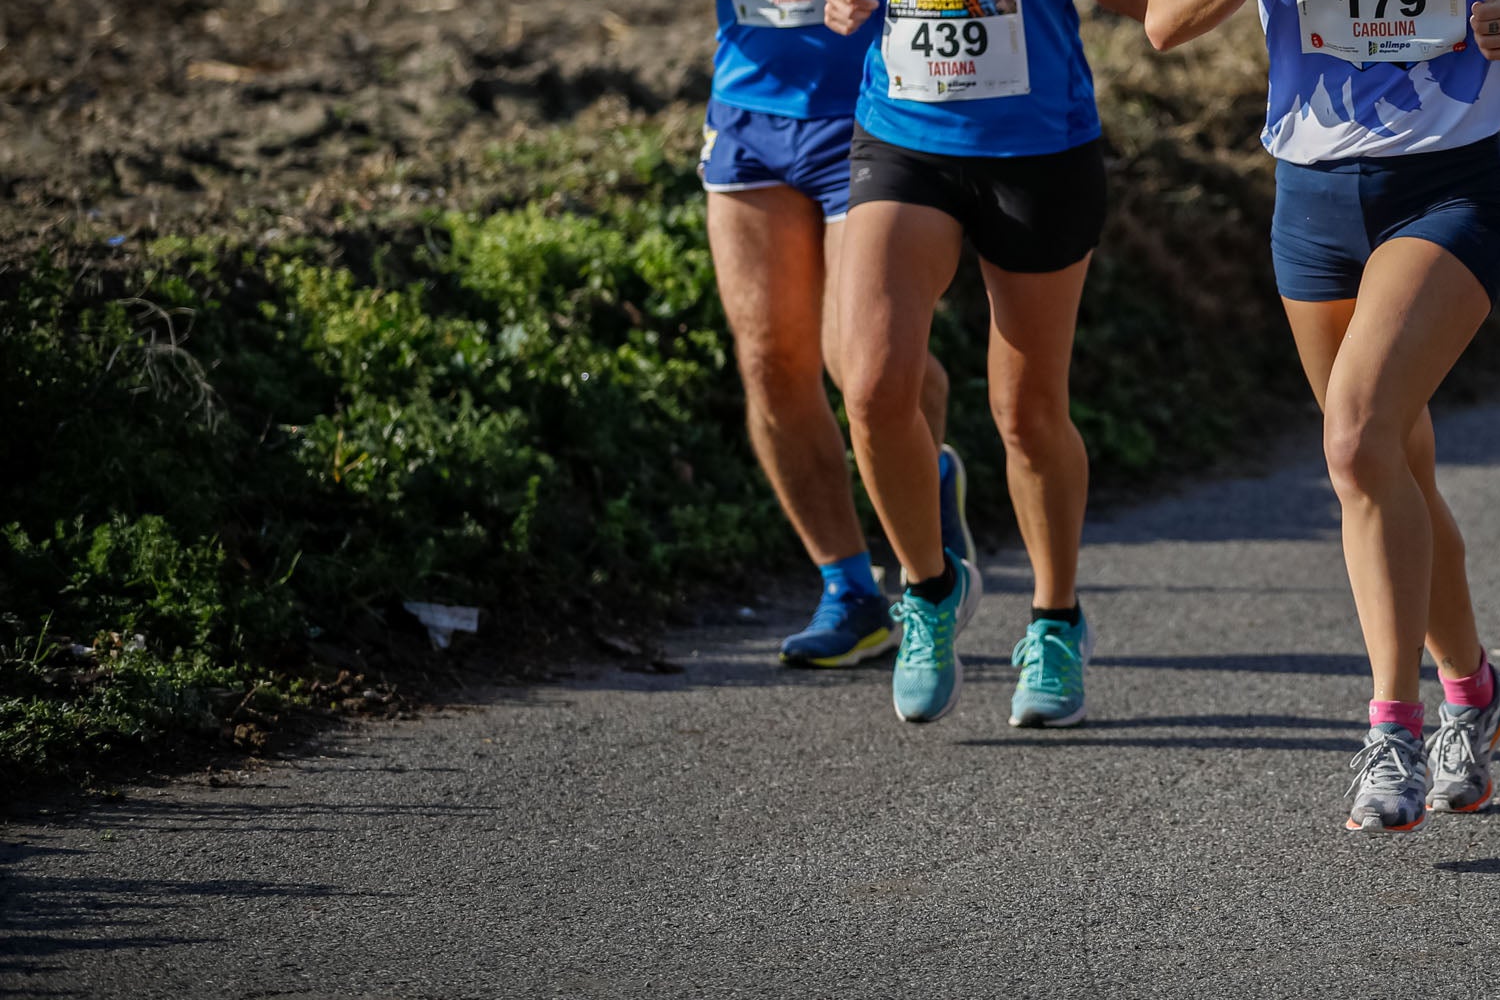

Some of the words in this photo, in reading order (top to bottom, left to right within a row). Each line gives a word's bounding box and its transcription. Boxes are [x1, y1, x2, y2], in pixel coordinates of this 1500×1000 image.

[1353, 20, 1416, 37] CAROLINA
[911, 21, 988, 58] 439
[1379, 41, 1411, 50] olimpo
[928, 61, 976, 76] TATIANA
